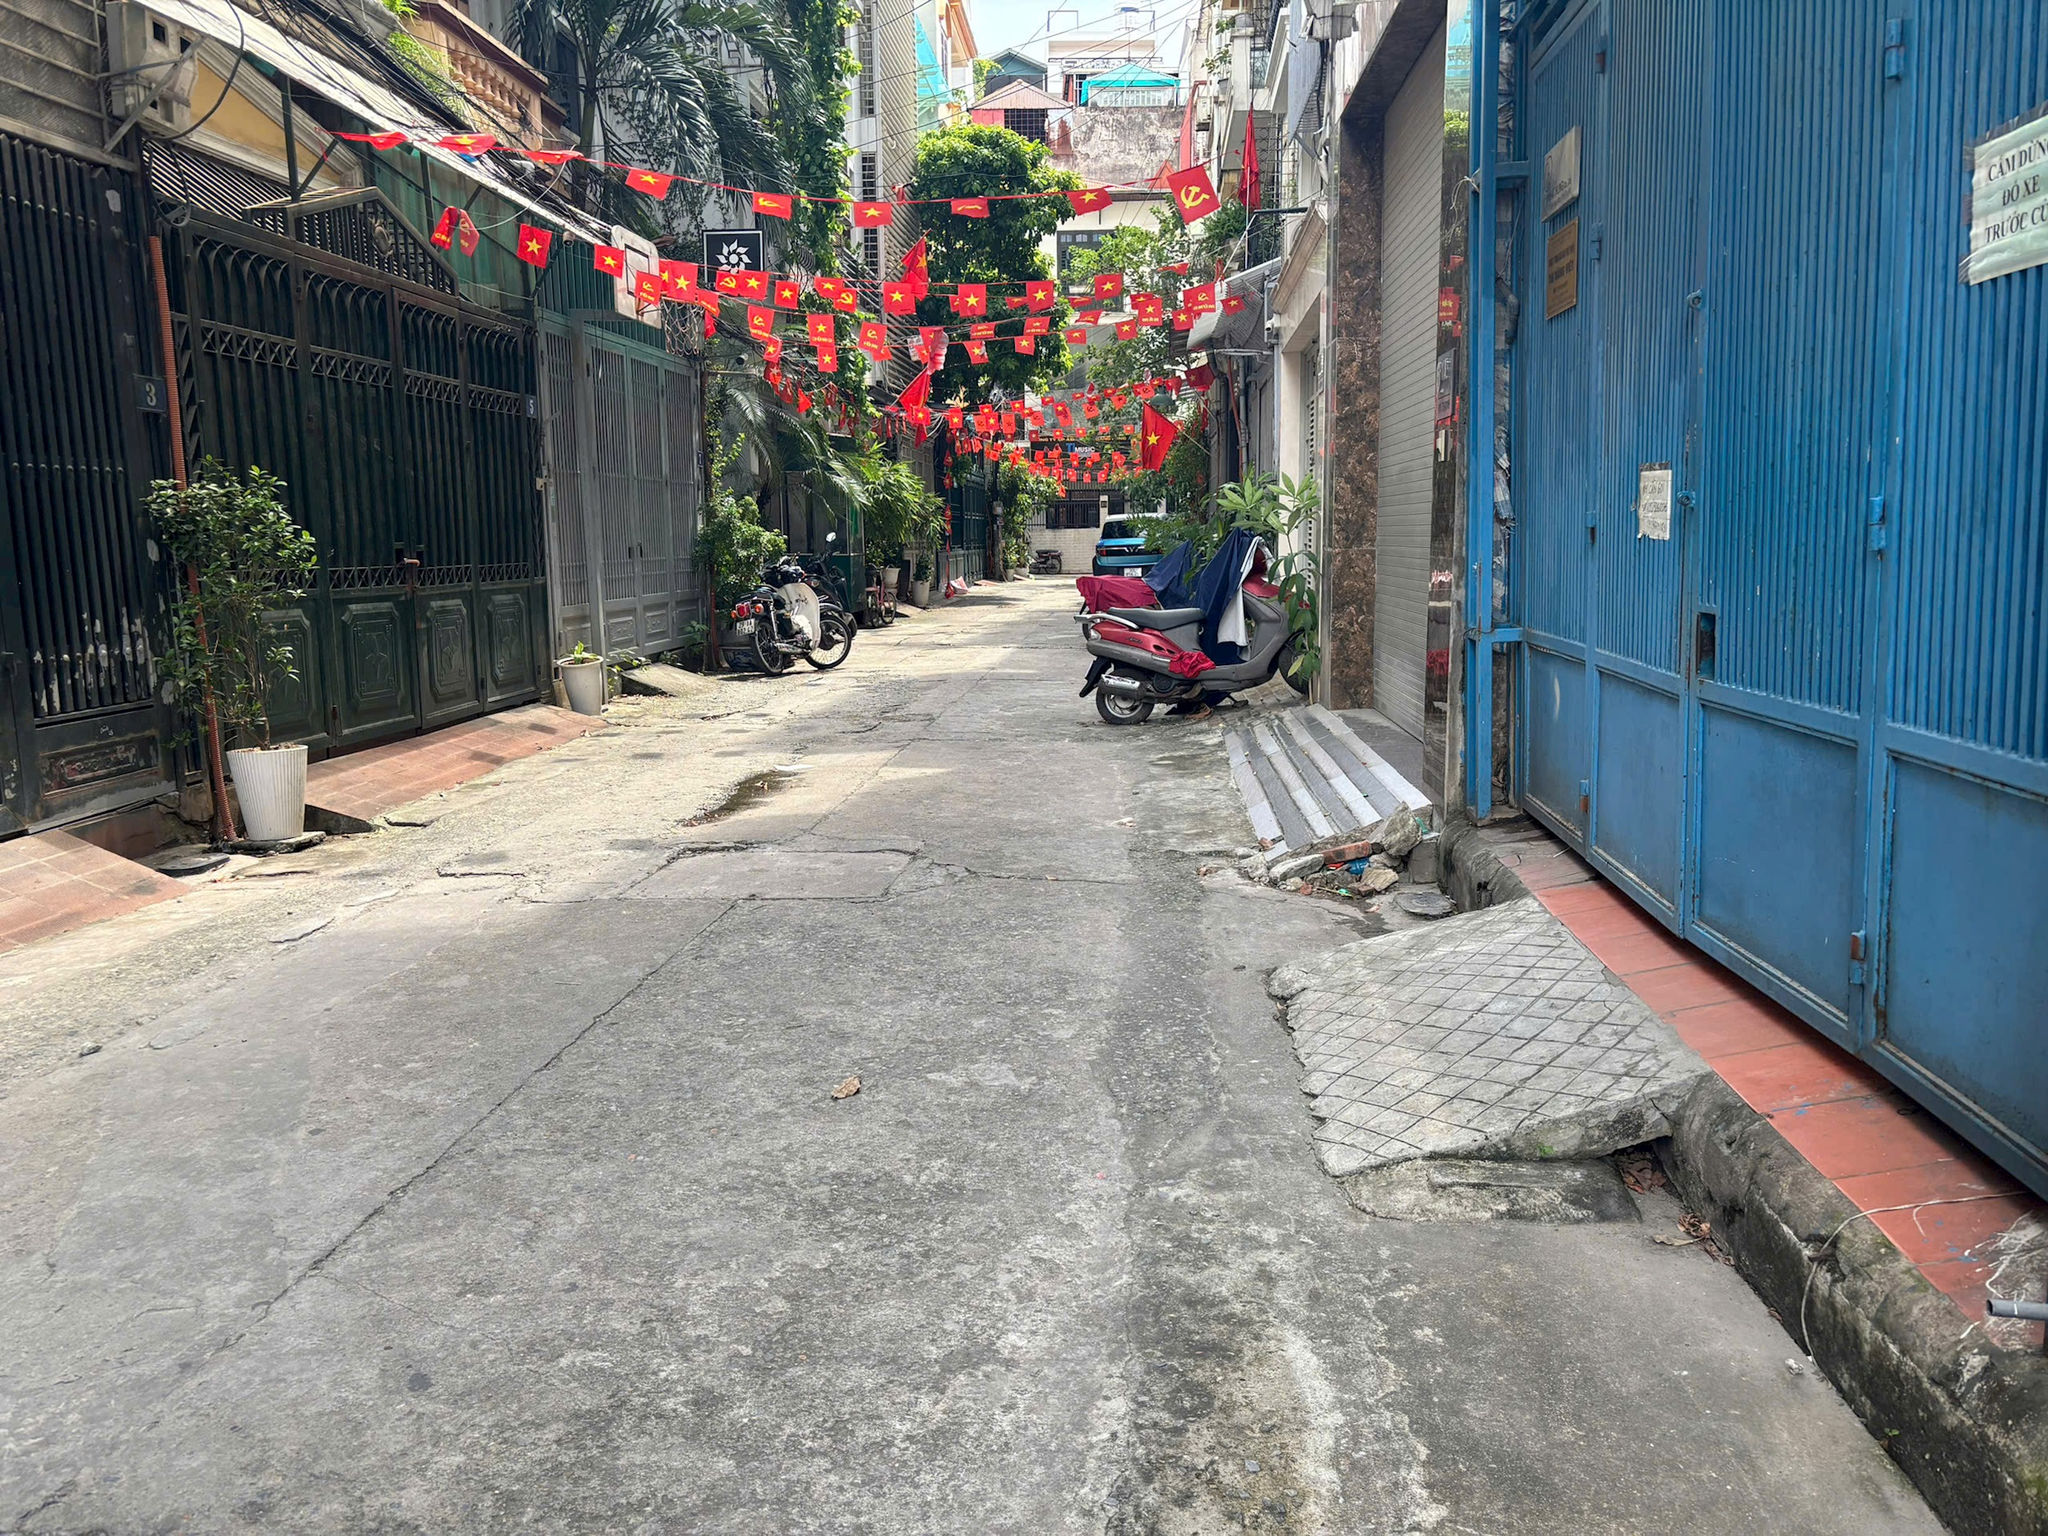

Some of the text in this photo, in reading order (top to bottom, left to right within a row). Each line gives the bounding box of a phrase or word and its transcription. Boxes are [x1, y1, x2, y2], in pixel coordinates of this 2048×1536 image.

[2020, 139, 2048, 167] DỪN
[2023, 174, 2040, 198] XE
[1985, 211, 2028, 243] TRƯỚC
[146, 382, 156, 407] 3
[530, 399, 535, 415] 5
